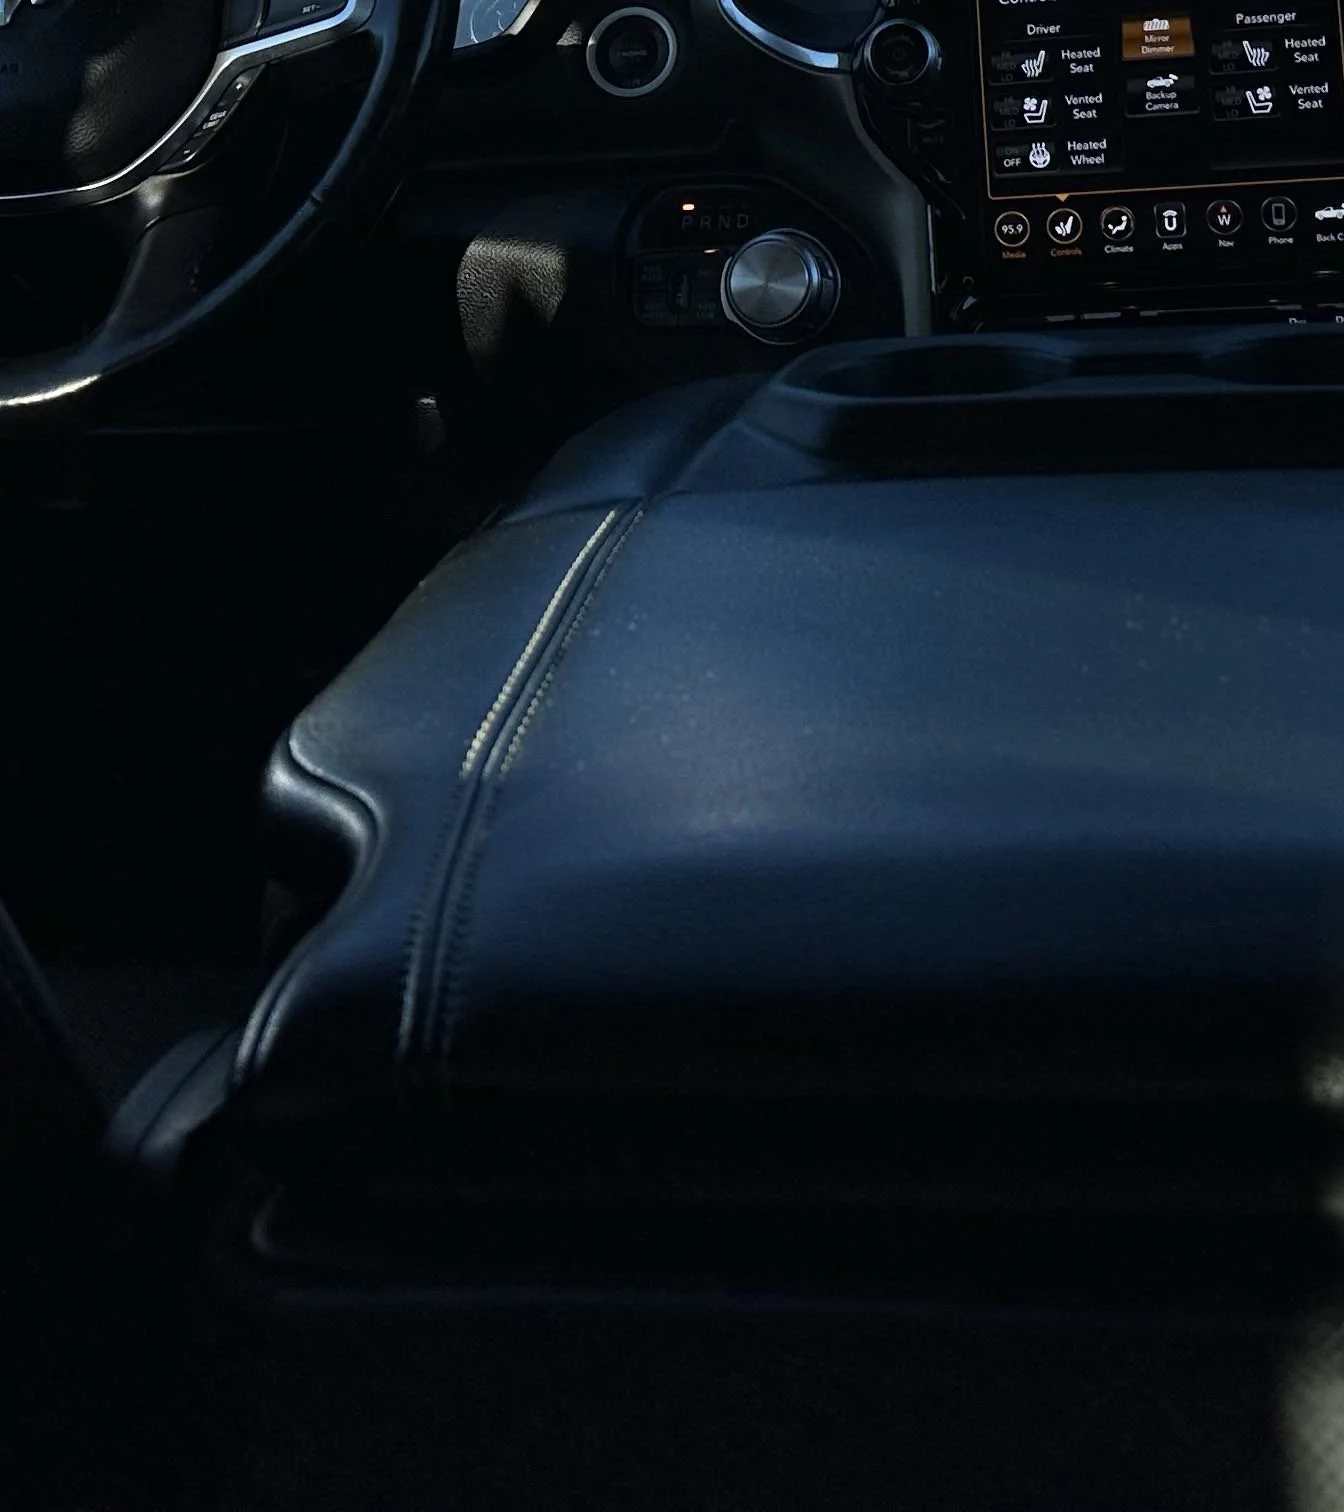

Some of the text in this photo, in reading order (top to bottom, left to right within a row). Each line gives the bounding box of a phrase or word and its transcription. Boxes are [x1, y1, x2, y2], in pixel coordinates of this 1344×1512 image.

[1235, 11, 1297, 27] Passenger
[1026, 23, 1061, 36] Driver
[1284, 36, 1326, 49] Heated
[1061, 46, 1101, 59] Heated
[1293, 52, 1319, 64] Seat
[1069, 62, 1094, 74] Seat
[1288, 81, 1329, 96] Vented
[1064, 92, 1103, 105] Vented
[1146, 90, 1177, 102] Backup
[1145, 100, 1179, 112] Camera
[1297, 98, 1324, 110] Seat
[1072, 108, 1098, 120] Seat
[1067, 138, 1107, 151] Heated
[1003, 157, 1021, 168] OFF
[1070, 152, 1105, 166] Wheel
[1217, 214, 1231, 226] W
[1001, 224, 1023, 235] 95.9
